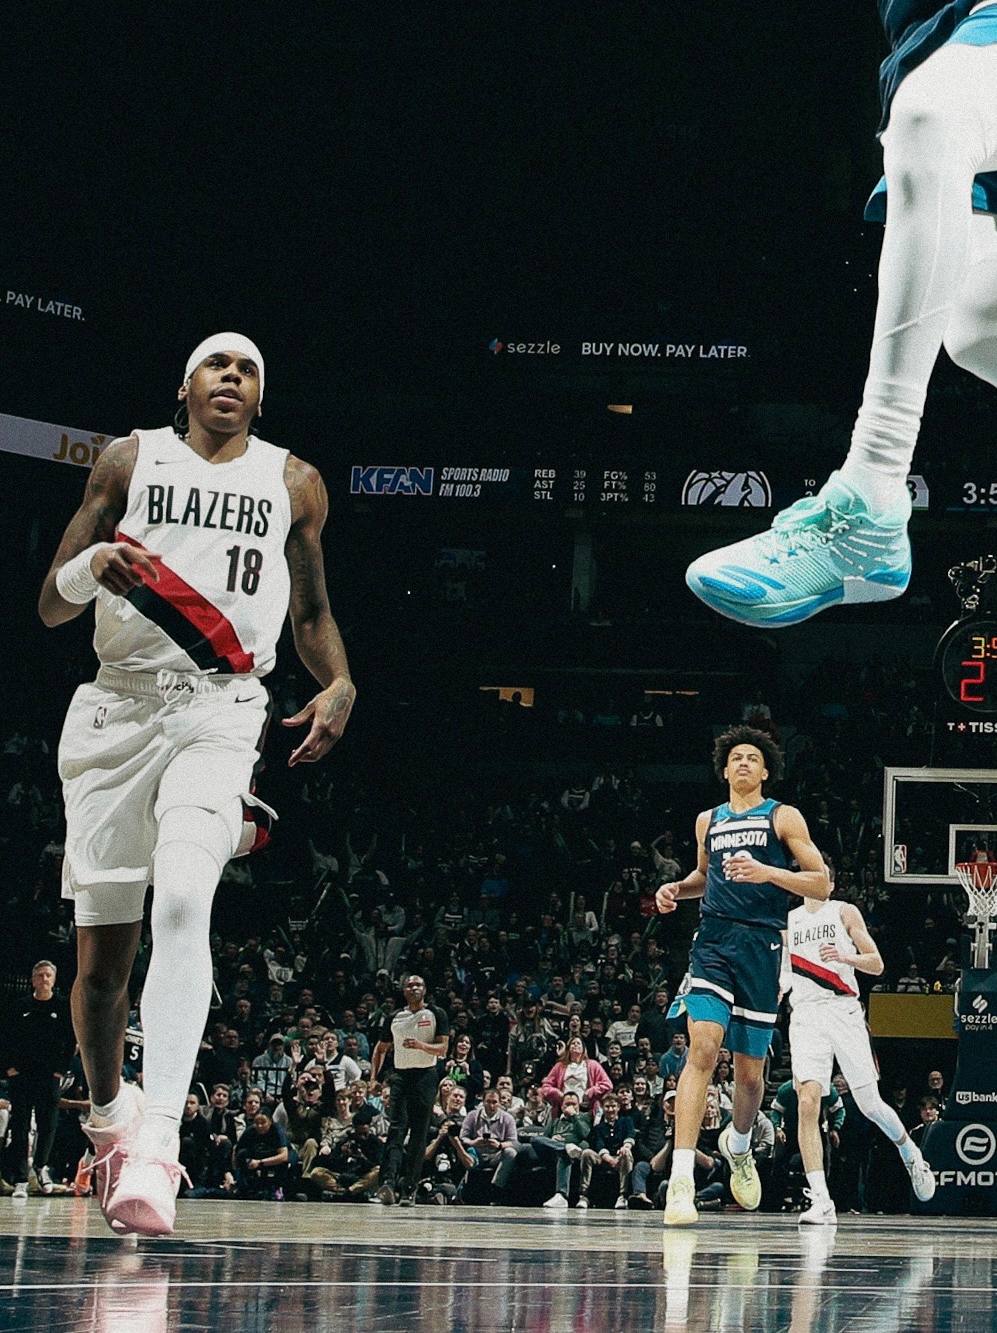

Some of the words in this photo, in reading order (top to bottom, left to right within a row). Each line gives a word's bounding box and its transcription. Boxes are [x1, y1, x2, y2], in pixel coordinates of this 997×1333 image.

[6, 290, 34, 309] PAY
[37, 297, 86, 321] LATER.
[507, 340, 561, 355] sezzle
[581, 342, 614, 356] BUY
[618, 343, 661, 357] NOW.
[666, 344, 695, 358] PAY
[53, 433, 106, 466] Joi
[350, 466, 434, 496] KFAN
[441, 467, 478, 481] SPORTS
[479, 468, 510, 482] RADIO
[534, 469, 556, 478] REB
[534, 480, 555, 489] AST
[439, 484, 453, 497] FM
[455, 484, 482, 497] 100.3
[533, 491, 553, 500] STL
[146, 484, 273, 538] BLAZERS
[226, 544, 263, 596] 18
[711, 830, 768, 852] MINNESOTA
[794, 924, 836, 946] BLAZERS
